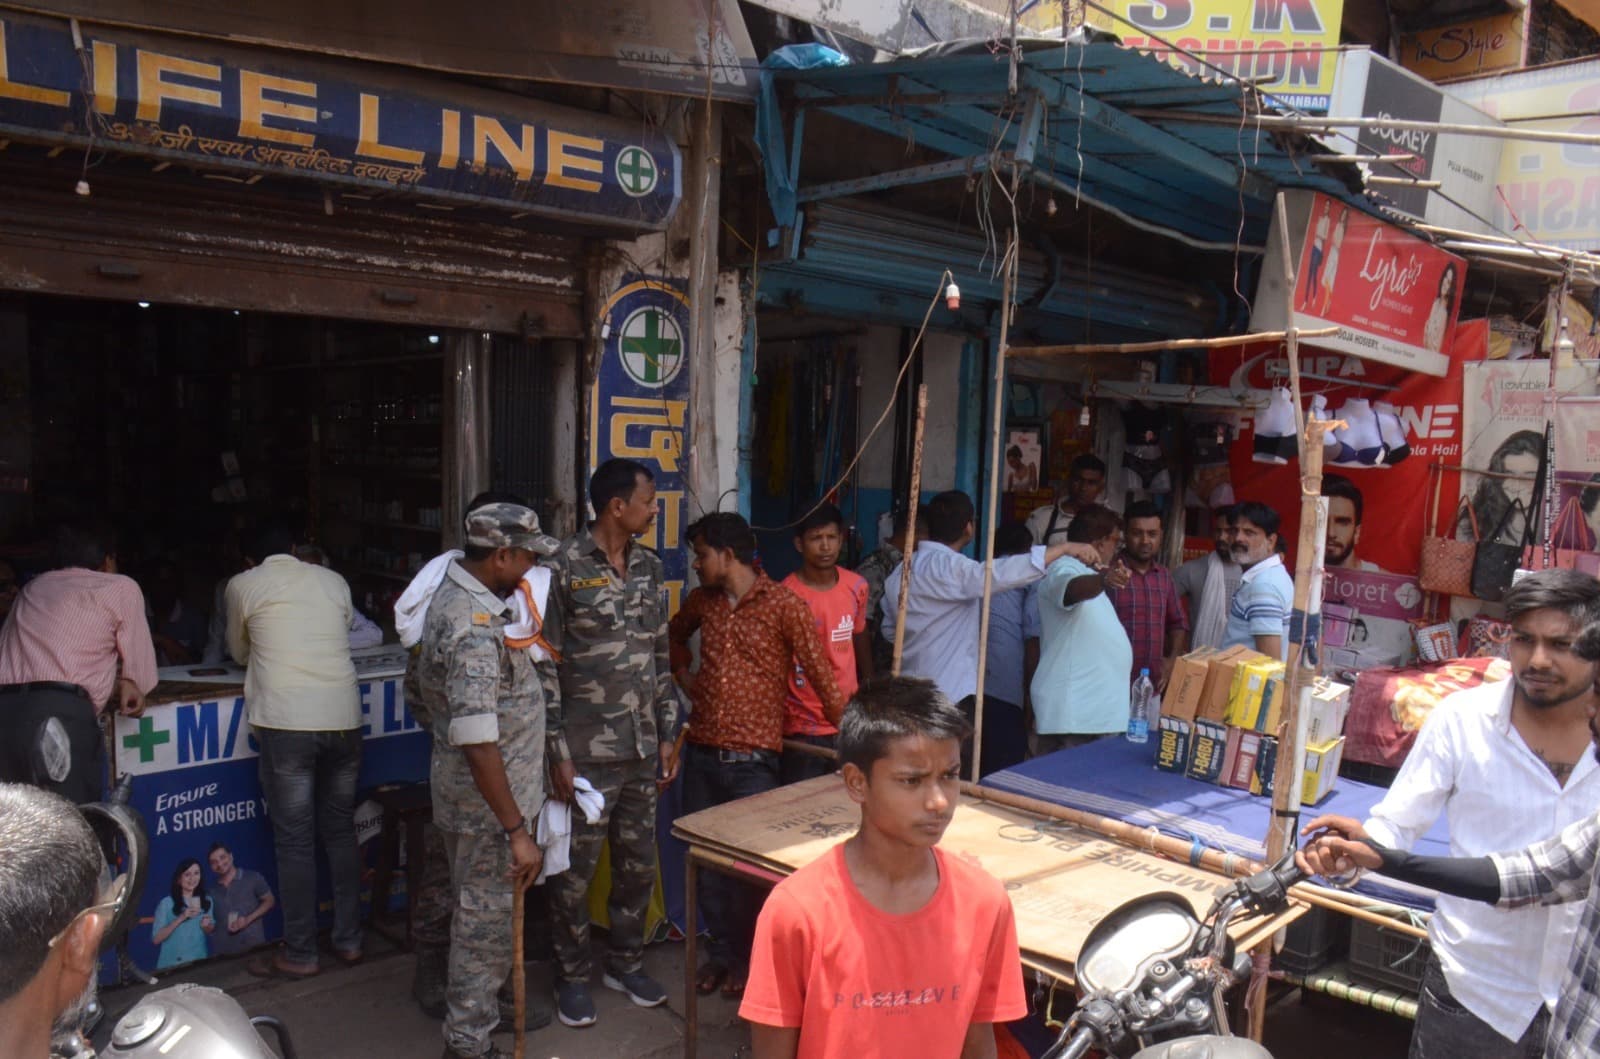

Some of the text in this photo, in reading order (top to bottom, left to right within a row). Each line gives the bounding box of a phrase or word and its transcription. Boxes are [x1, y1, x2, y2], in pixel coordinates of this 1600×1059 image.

[1123, 37, 1325, 89] SHION
[356, 93, 604, 193] LINE
[1360, 228, 1411, 311] Lyra
[1432, 444, 1459, 456] Hai!
[155, 782, 218, 812] Ensure
[156, 819, 167, 835] A
[173, 800, 256, 833] STRONGER
[353, 815, 385, 833] nsure
